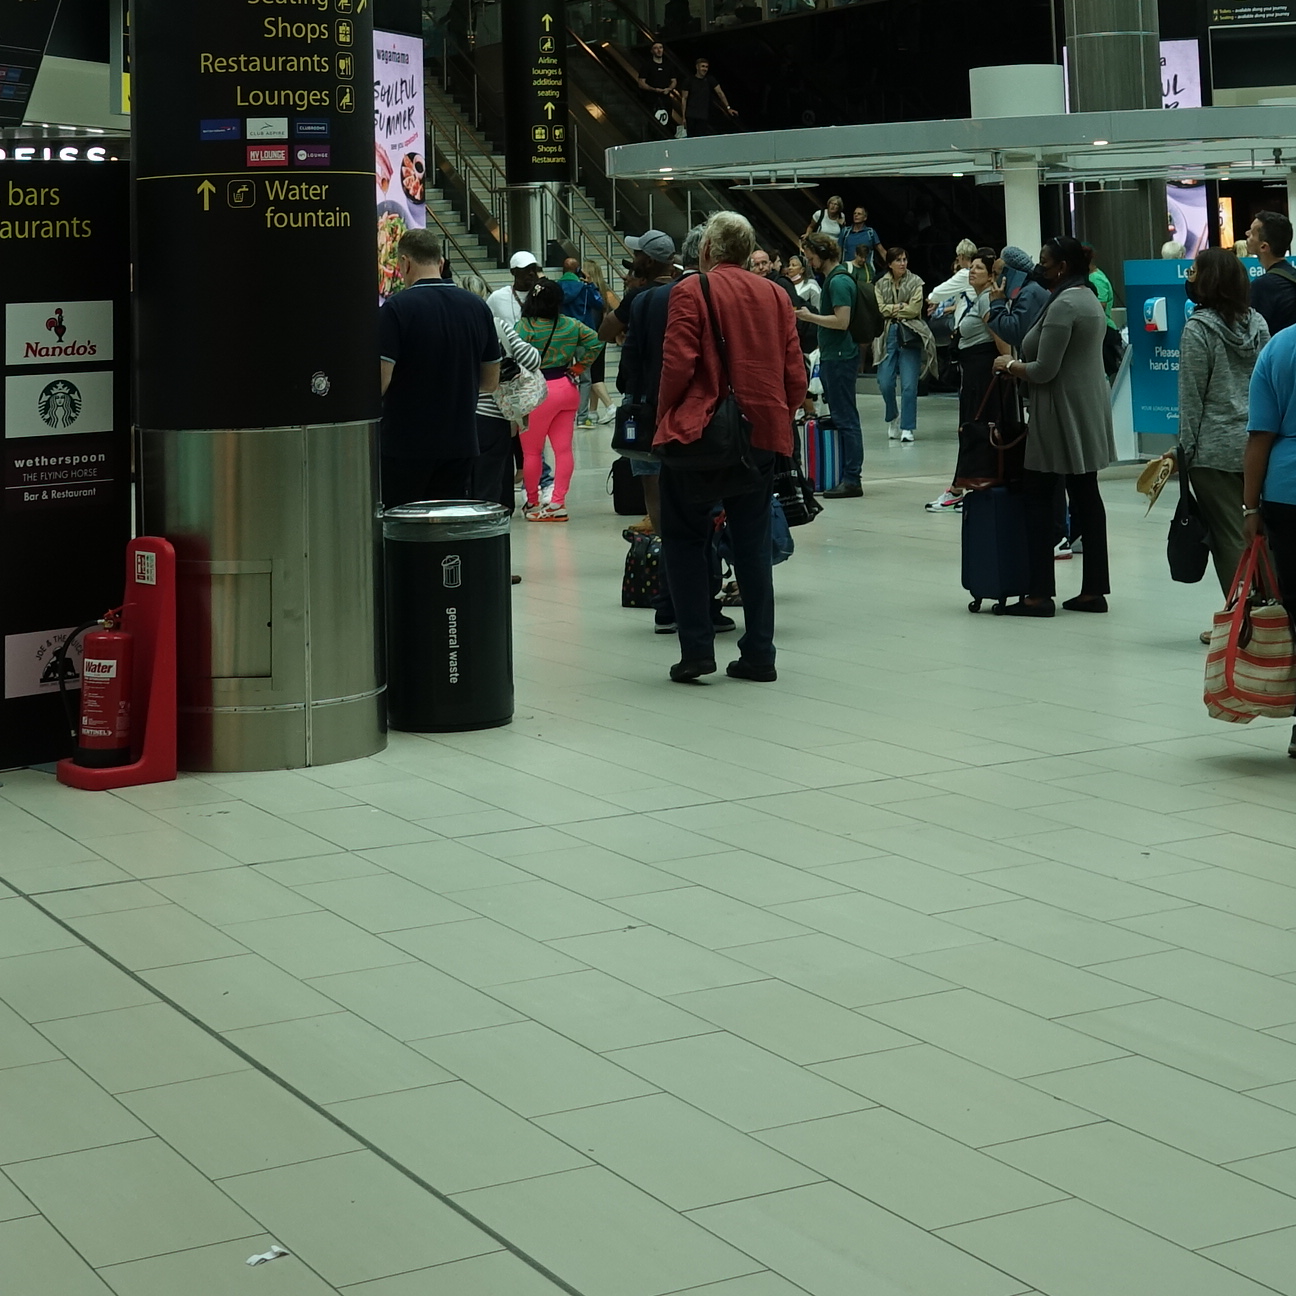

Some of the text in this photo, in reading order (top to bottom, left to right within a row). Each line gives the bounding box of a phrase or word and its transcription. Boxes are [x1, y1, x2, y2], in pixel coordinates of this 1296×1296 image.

[263, 17, 329, 44] Shops
[200, 52, 330, 75] Restaurants
[376, 49, 409, 64] wagamama
[532, 67, 557, 76] lounges
[532, 78, 563, 86] additional
[373, 74, 417, 108] SOULFUL
[537, 89, 560, 98] seating
[236, 86, 330, 112] Lounges
[374, 105, 416, 139] SUMMER
[260, 150, 286, 160] LOUNGE
[537, 145, 558, 154] Shops
[532, 155, 566, 164] Restaurants
[8, 180, 60, 206] bars
[265, 180, 329, 202] Water
[264, 207, 351, 229] fountain
[24, 340, 97, 358] Nando's
[1155, 346, 1180, 358] Please
[1149, 358, 1169, 371] hand
[14, 453, 106, 468] wetherspoon
[22, 468, 98, 482] THE FLYING HORSE
[23, 487, 96, 502] Bar & Restaurant
[35, 634, 67, 661] JOE THE
[445, 607, 460, 684] general waste
[85, 661, 114, 673] Water
